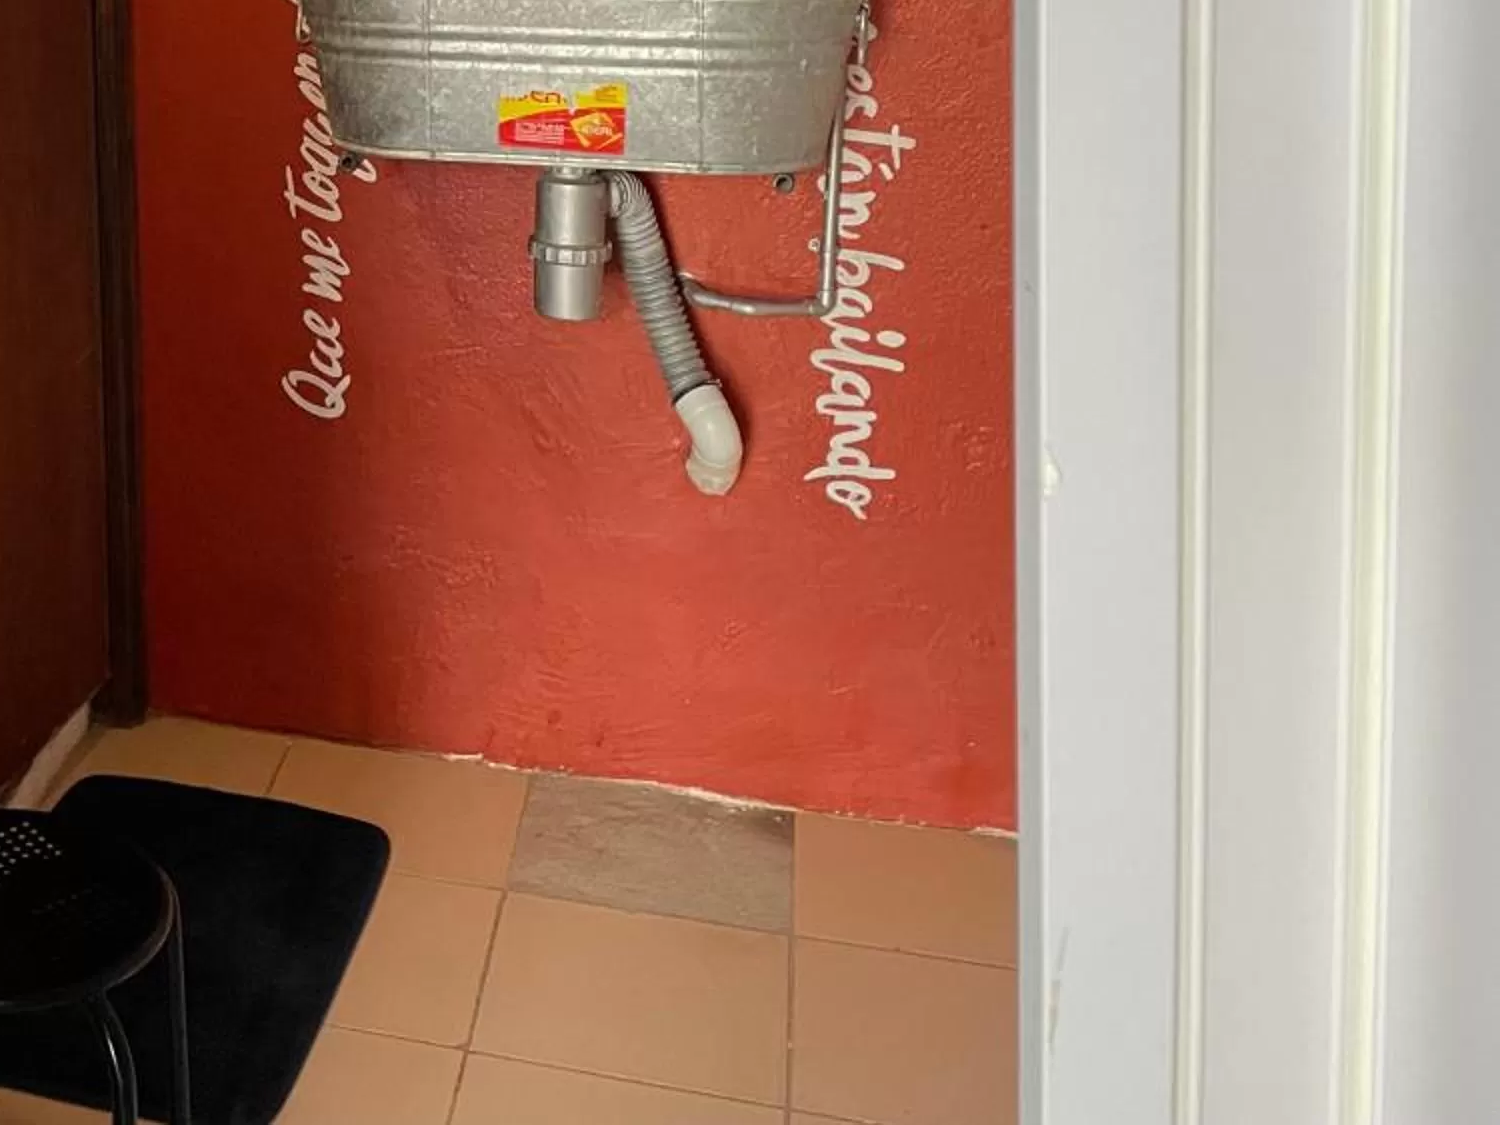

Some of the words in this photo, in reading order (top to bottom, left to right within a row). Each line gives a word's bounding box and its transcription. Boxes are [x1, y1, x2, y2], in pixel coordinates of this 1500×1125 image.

[301, 228, 350, 302] me
[281, 309, 351, 418] Que
[803, 247, 906, 520] bailando
